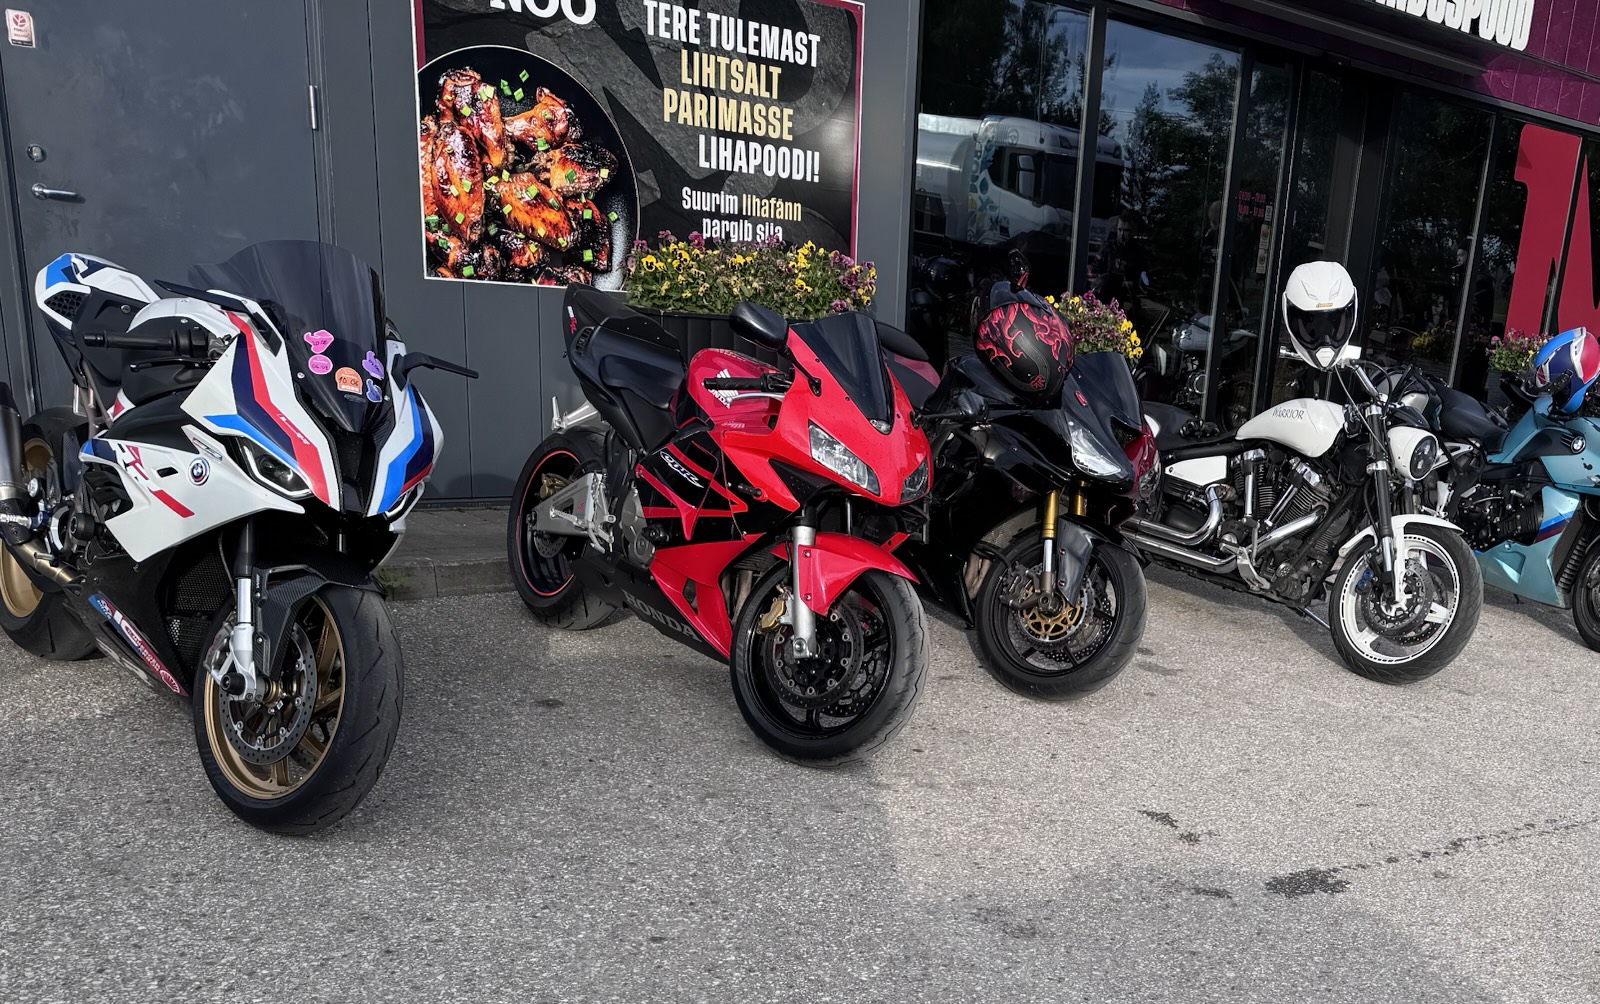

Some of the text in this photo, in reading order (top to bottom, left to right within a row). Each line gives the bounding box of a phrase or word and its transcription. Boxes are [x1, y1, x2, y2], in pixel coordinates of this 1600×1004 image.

[643, 0, 821, 67] TERE TULEMAST
[681, 49, 781, 99] LIHTSALT
[663, 88, 793, 141] PARIMASSE
[698, 134, 820, 183] LIHAPOODI!
[682, 186, 739, 215] Suurim
[1272, 407, 1305, 420] WARRIOR
[622, 589, 702, 643] HONDA
